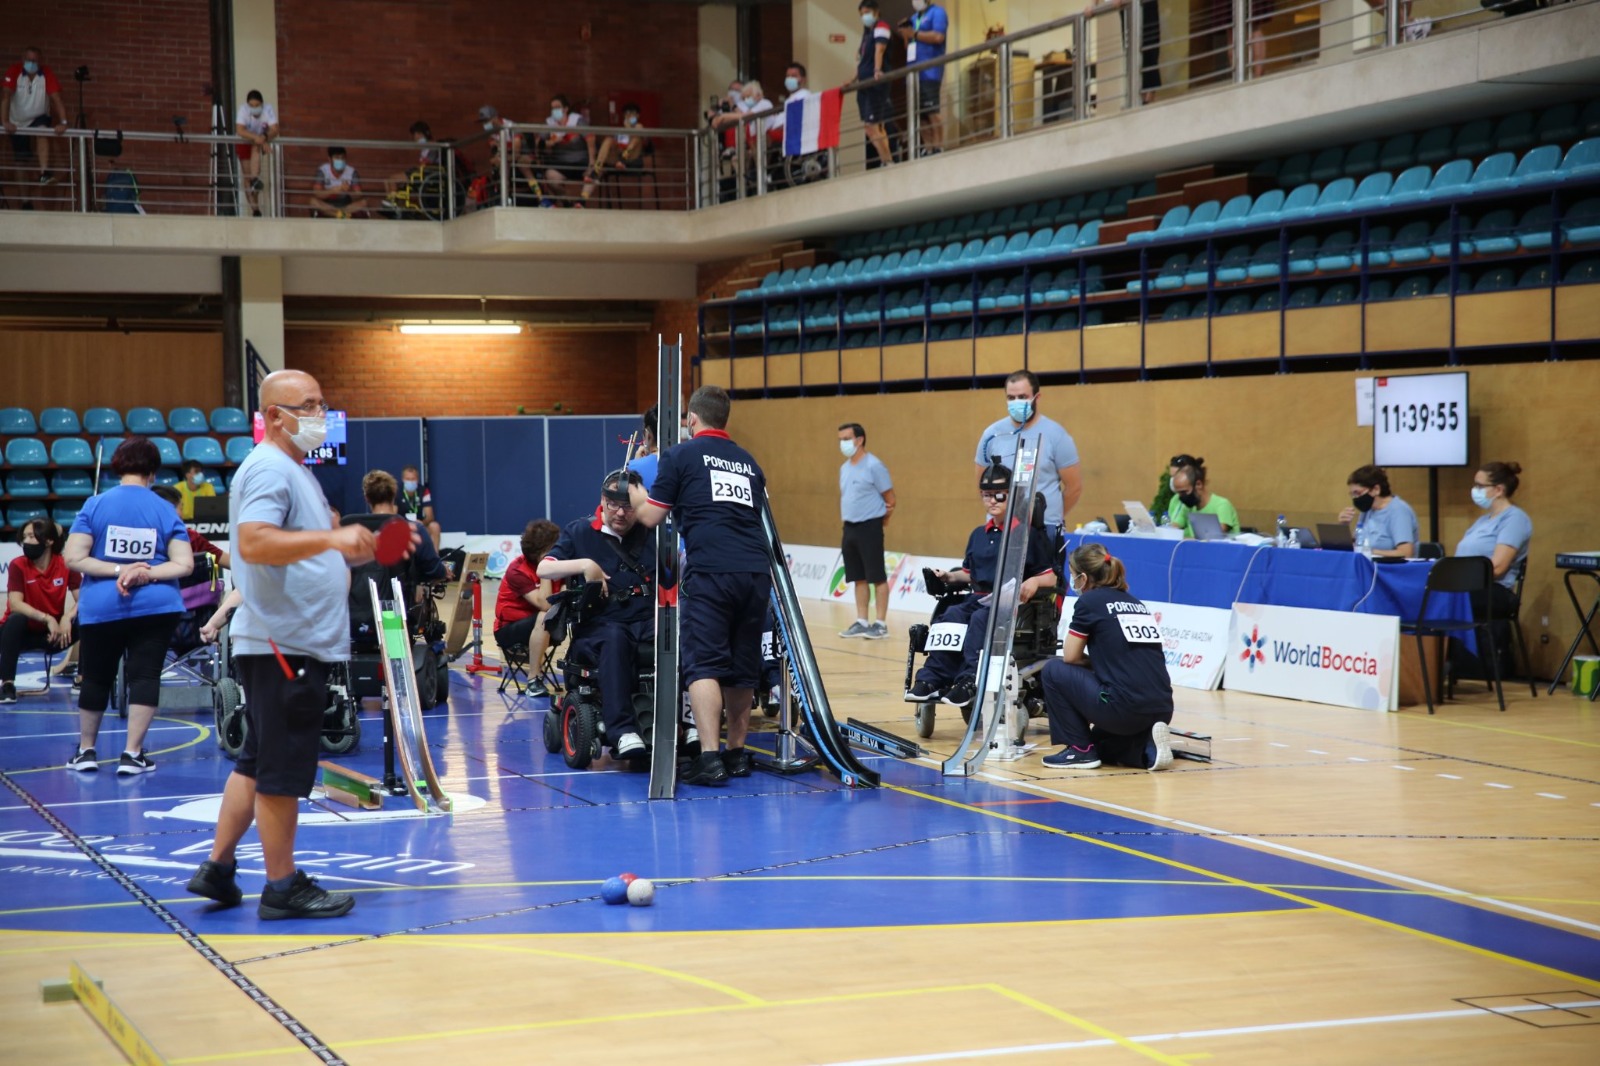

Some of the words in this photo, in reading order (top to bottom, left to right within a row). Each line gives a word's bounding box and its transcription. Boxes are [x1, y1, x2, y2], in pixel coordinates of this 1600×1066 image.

[1381, 401, 1459, 434] 11:39:55
[702, 454, 756, 476] PORTUGAL
[714, 482, 751, 502] 2305
[109, 538, 153, 555] 1305
[1106, 601, 1151, 615] PORTUG
[929, 633, 961, 647] 1303
[1125, 625, 1160, 639] 1303
[1274, 640, 1378, 676] WorldBoccia
